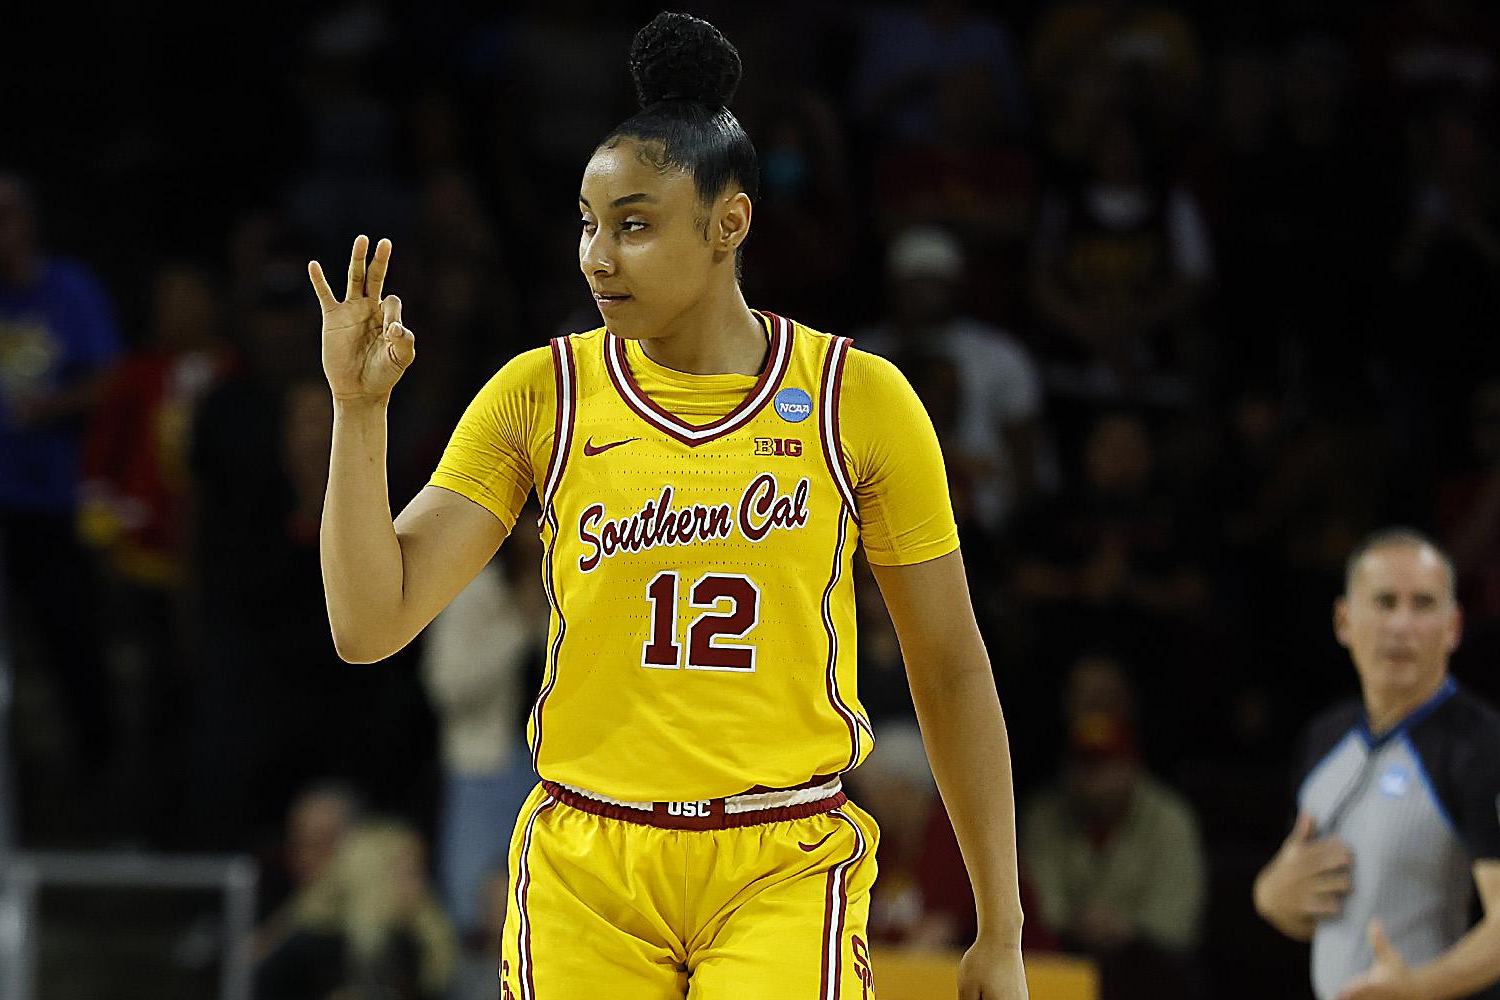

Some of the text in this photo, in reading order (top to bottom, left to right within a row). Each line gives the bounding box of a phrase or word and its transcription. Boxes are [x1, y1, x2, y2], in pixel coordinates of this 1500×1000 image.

[779, 402, 810, 414] NCAA
[577, 472, 810, 573] Southern Cal
[641, 570, 760, 673] 12
[668, 799, 711, 817] USC
